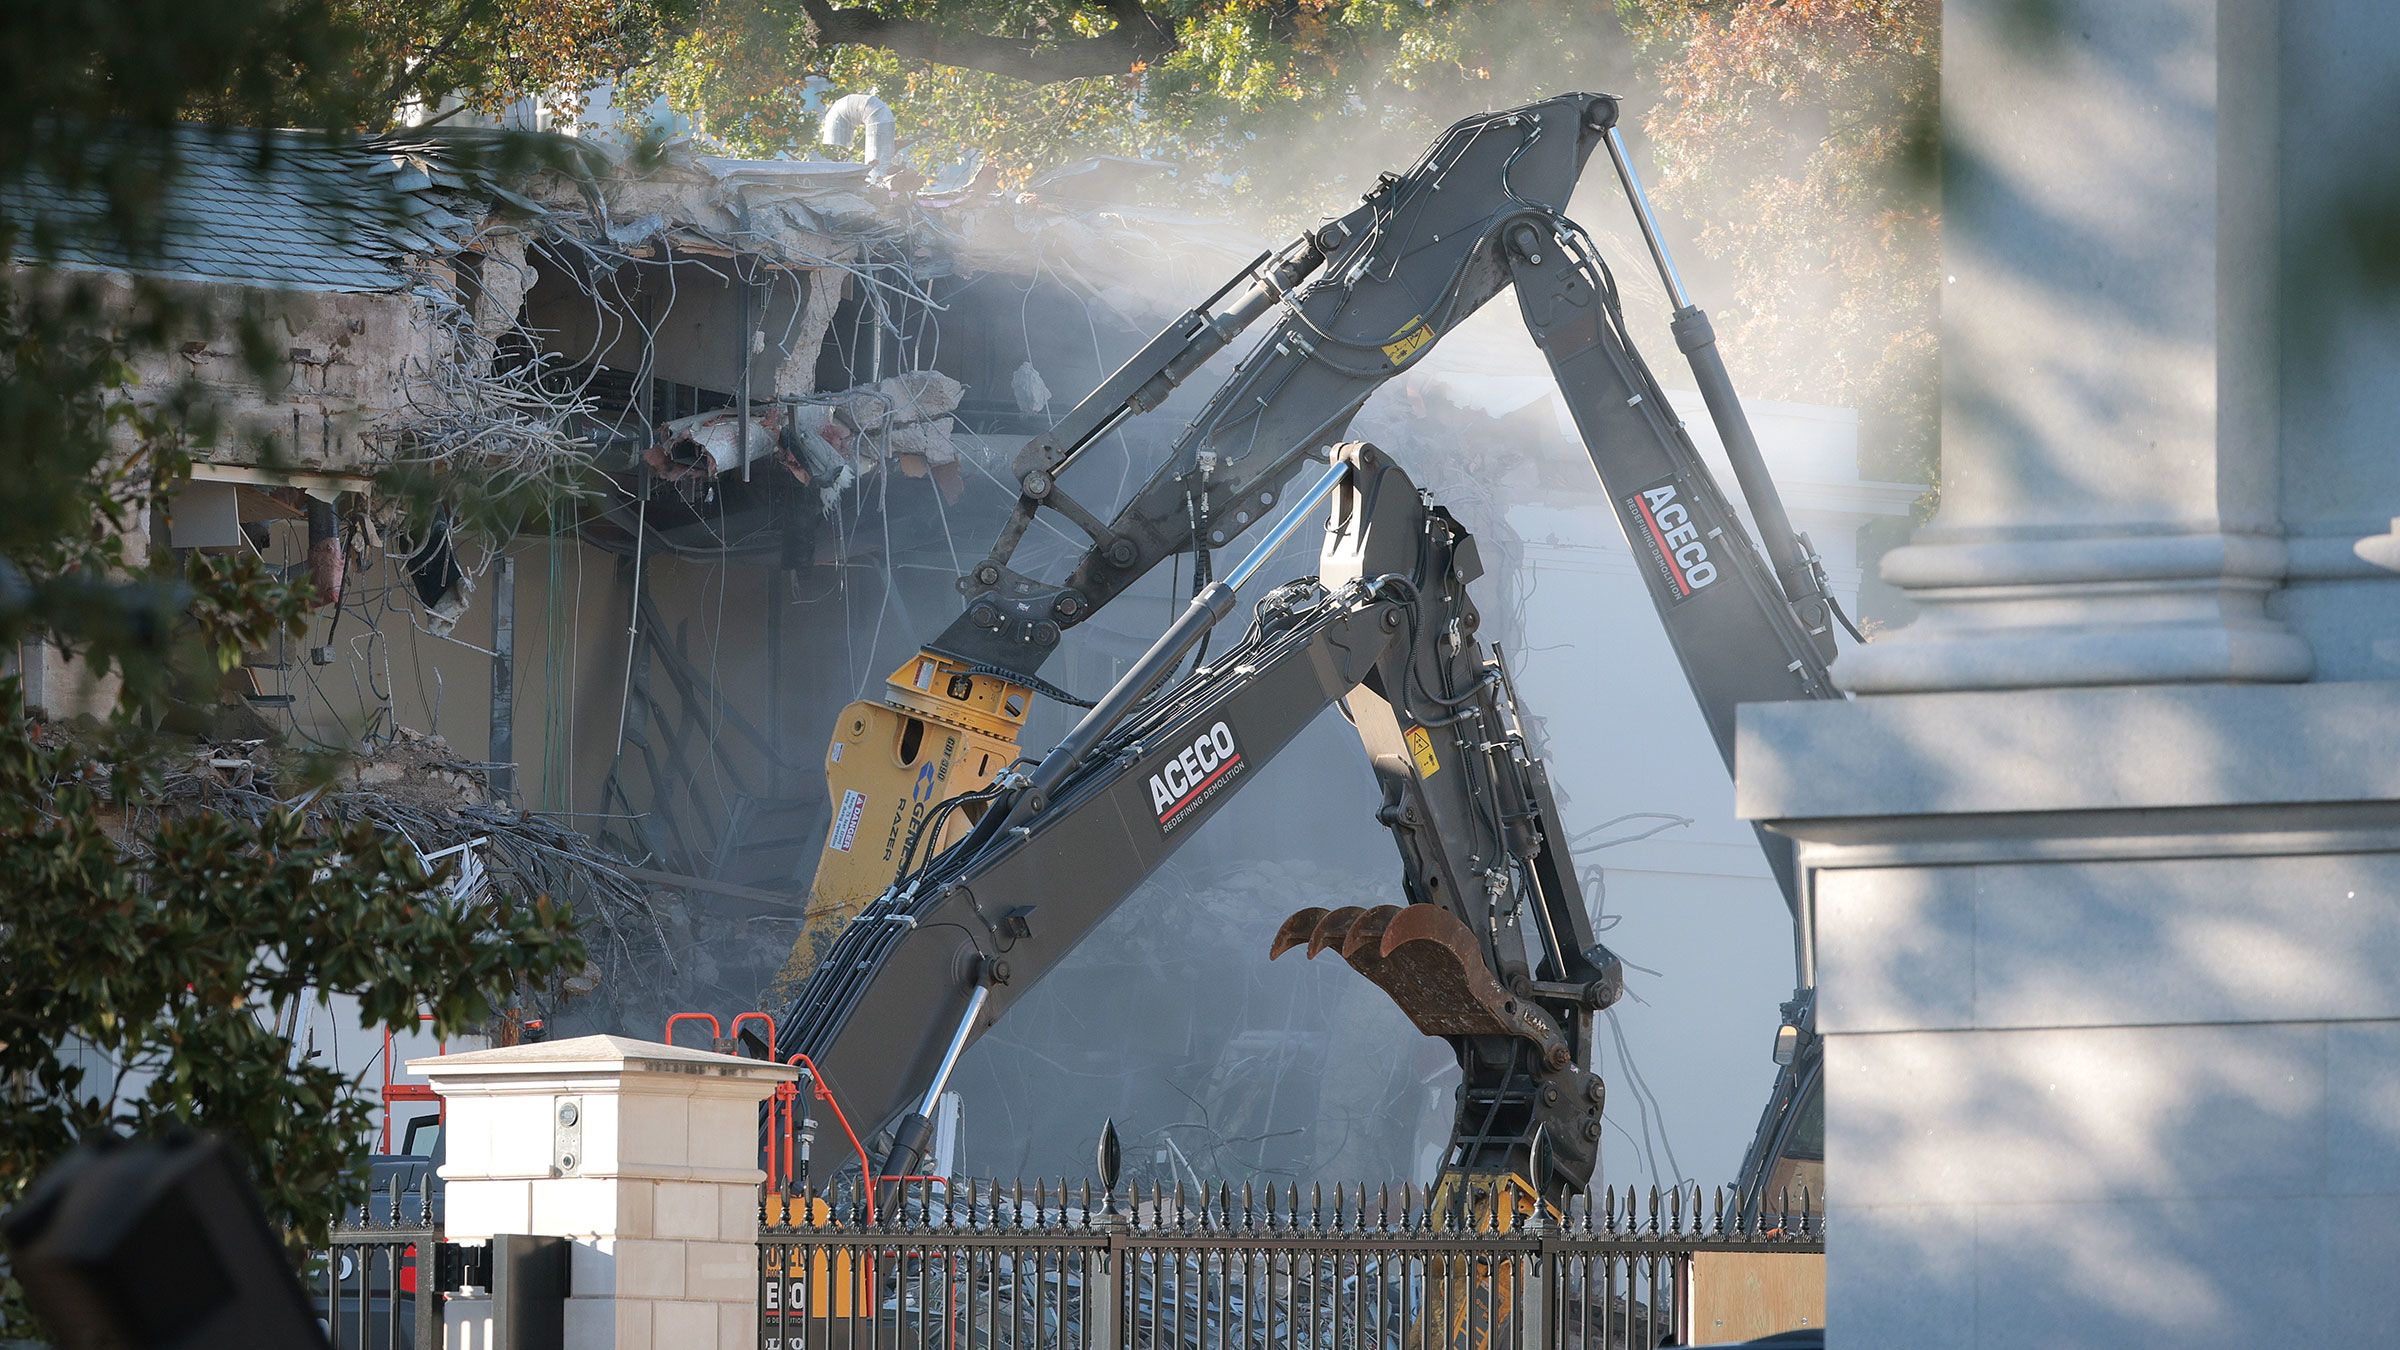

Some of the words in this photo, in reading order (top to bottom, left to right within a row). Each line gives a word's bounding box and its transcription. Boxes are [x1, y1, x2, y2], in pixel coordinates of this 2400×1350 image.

[1626, 498, 1655, 548] REDEFINING
[1651, 548, 1682, 600] DEMOLITION
[1643, 485, 1717, 589] ACECO
[1149, 721, 1235, 815] ACECO
[1162, 796, 1204, 834] REDEFINING
[1203, 761, 1245, 799] DEMOLITION
[843, 808, 861, 848] DANGER
[883, 798, 906, 861] RAZER
[896, 802, 925, 877] GENE
